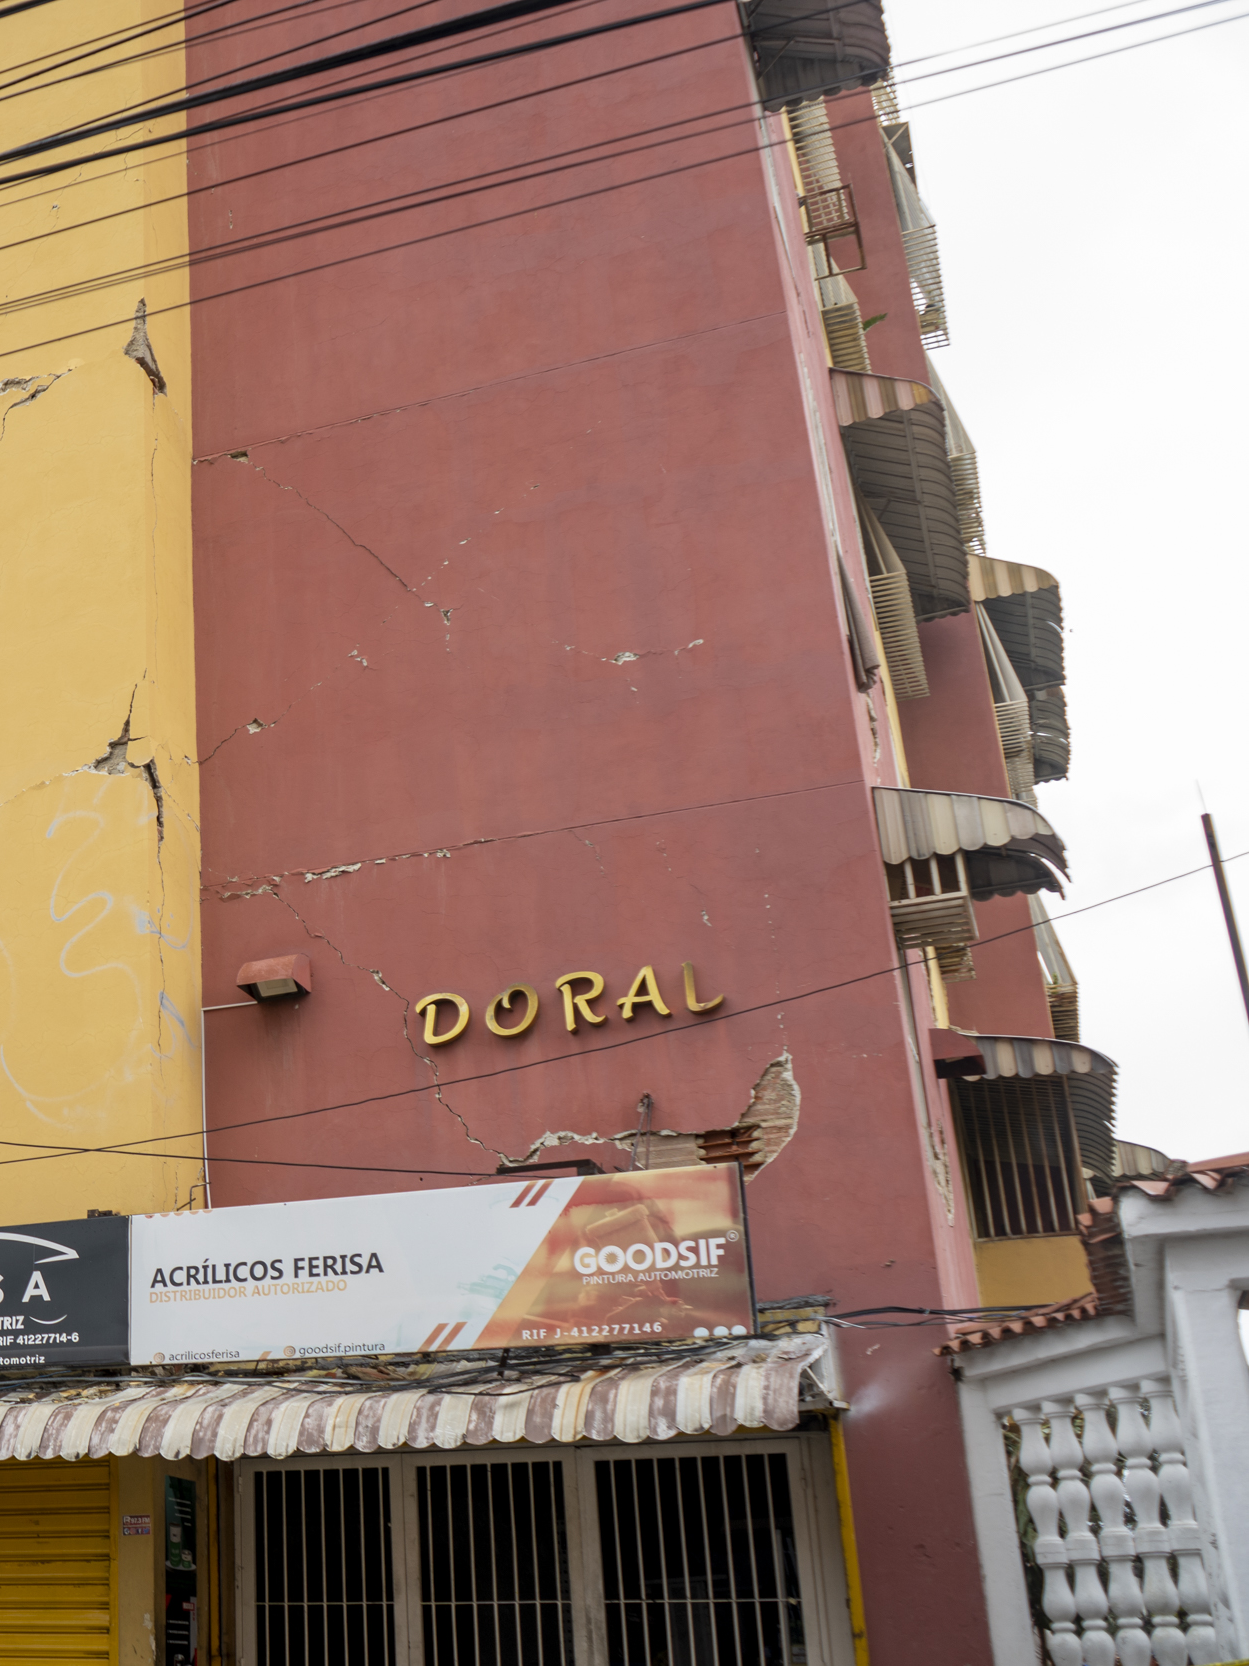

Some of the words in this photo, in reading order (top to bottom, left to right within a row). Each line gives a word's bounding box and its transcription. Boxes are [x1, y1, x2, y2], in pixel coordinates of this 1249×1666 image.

[415, 960, 725, 1047] DORAL
[574, 1237, 726, 1275] GOODSIF
[150, 1258, 284, 1288] ACRÍLICOS
[293, 1252, 385, 1278] FERISA
[582, 1274, 635, 1285] PINTURA
[637, 1268, 720, 1282] AUTOMOTRIZ
[149, 1286, 248, 1304] DISTRIBUIDOR
[251, 1279, 348, 1297] AUTORIZADO
[16, 1332, 80, 1346] 41227714-6
[522, 1329, 547, 1340] RIF
[554, 1321, 662, 1338] J-412277146
[168, 1349, 240, 1362] acrilicosferisa
[298, 1342, 386, 1357] goodsif.pintura
